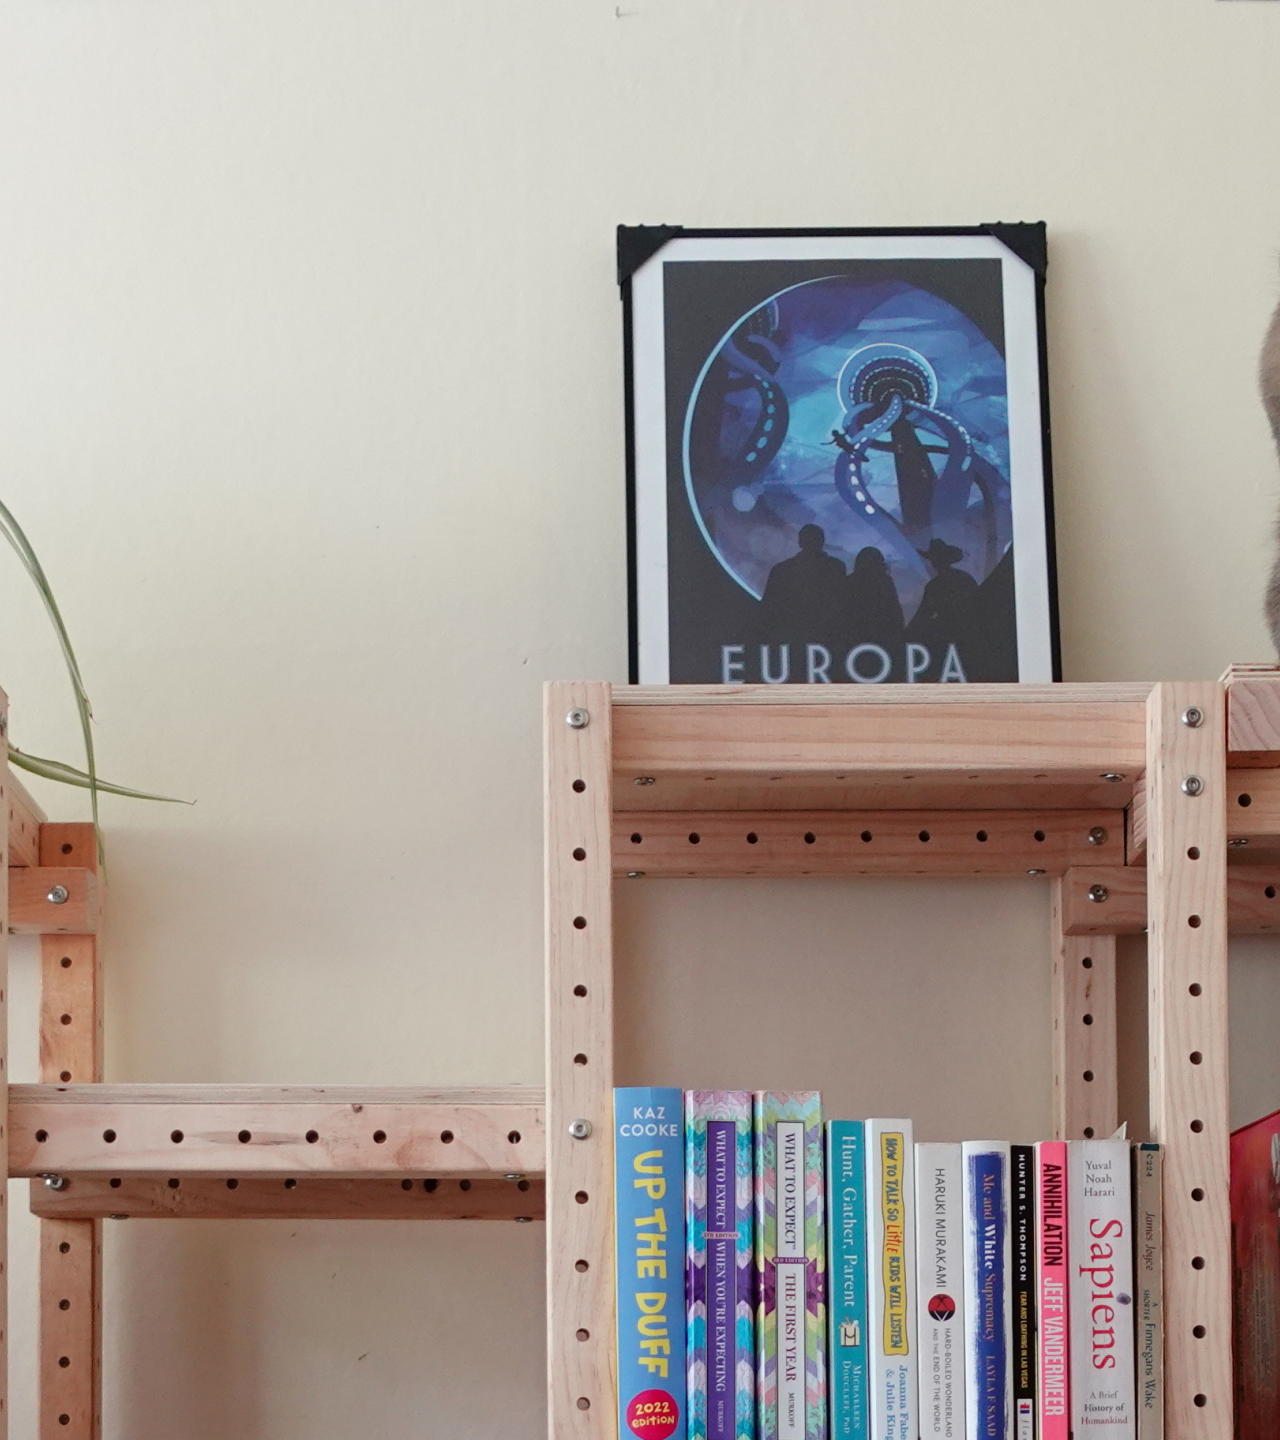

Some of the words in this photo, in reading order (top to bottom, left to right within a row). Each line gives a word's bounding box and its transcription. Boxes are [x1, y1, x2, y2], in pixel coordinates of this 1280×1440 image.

[721, 644, 967, 684] EUROPA
[621, 1124, 678, 1137] COOKE
[634, 1106, 665, 1119] KAZ
[785, 1133, 796, 1171] WHAT
[840, 1136, 858, 1182] Hunt,
[1086, 1161, 1112, 1170] Yuval
[634, 1150, 666, 1200] UP
[785, 1174, 796, 1193] TO
[935, 1168, 946, 1215] HARUKI
[1084, 1189, 1115, 1198] Harari
[1086, 1174, 1112, 1183] Noah
[785, 1196, 796, 1245] EXPECT
[840, 1188, 858, 1248] Gather,
[1044, 1164, 1062, 1266] ANNIHILATION
[635, 1208, 668, 1278] THE
[935, 1219, 946, 1288] MURAKAMI
[786, 1274, 796, 1301] THE
[843, 1255, 858, 1306] Parent
[1045, 1278, 1063, 1311] JEFF
[1080, 1219, 1123, 1370] Sapiens
[635, 1293, 670, 1377] DUFF
[786, 1305, 796, 1341] FIRST
[786, 1346, 796, 1381] YEAR
[1045, 1316, 1064, 1415] VANDERMEER
[635, 1402, 670, 1415] 2022
